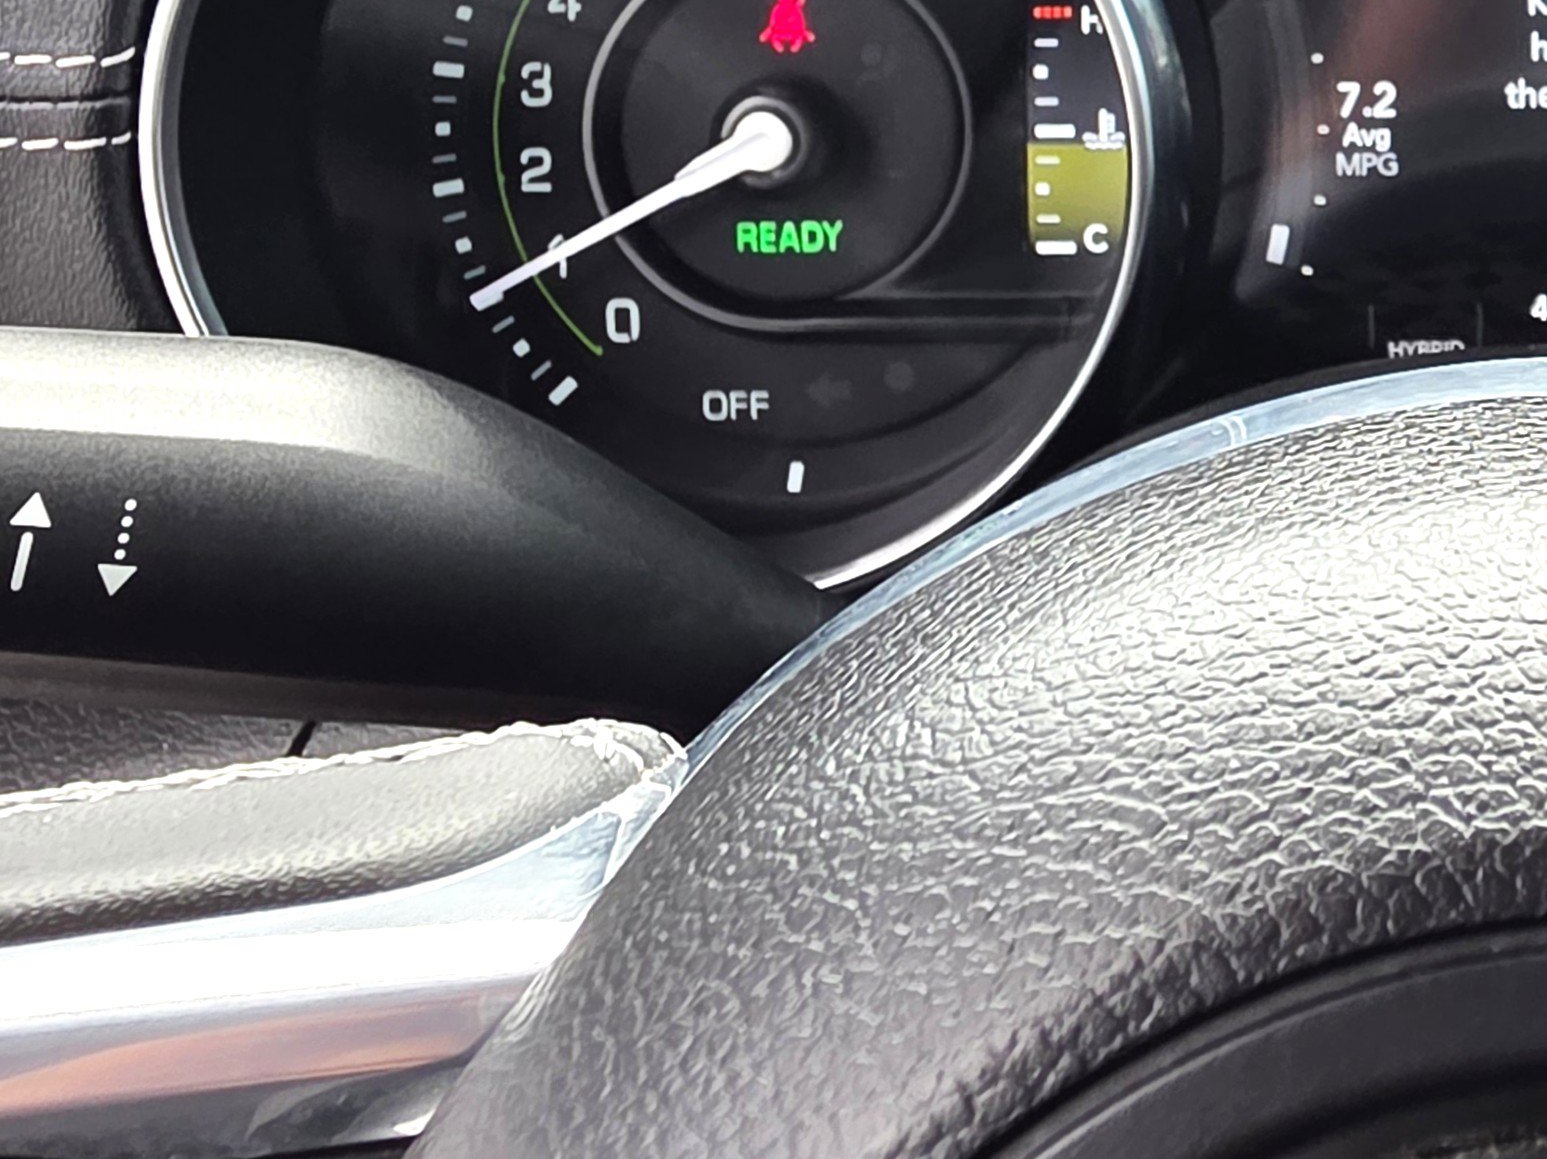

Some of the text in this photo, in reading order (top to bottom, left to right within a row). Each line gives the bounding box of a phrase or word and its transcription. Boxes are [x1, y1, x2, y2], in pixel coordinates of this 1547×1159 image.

[521, 62, 552, 107] 3
[1337, 81, 1396, 118] 7.2
[1342, 122, 1391, 152] Avg
[520, 147, 552, 192] 2
[1336, 153, 1398, 177] MPG
[737, 220, 843, 253] READY
[1083, 222, 1109, 253] C
[606, 298, 640, 343] 0
[703, 390, 769, 420] OFF
